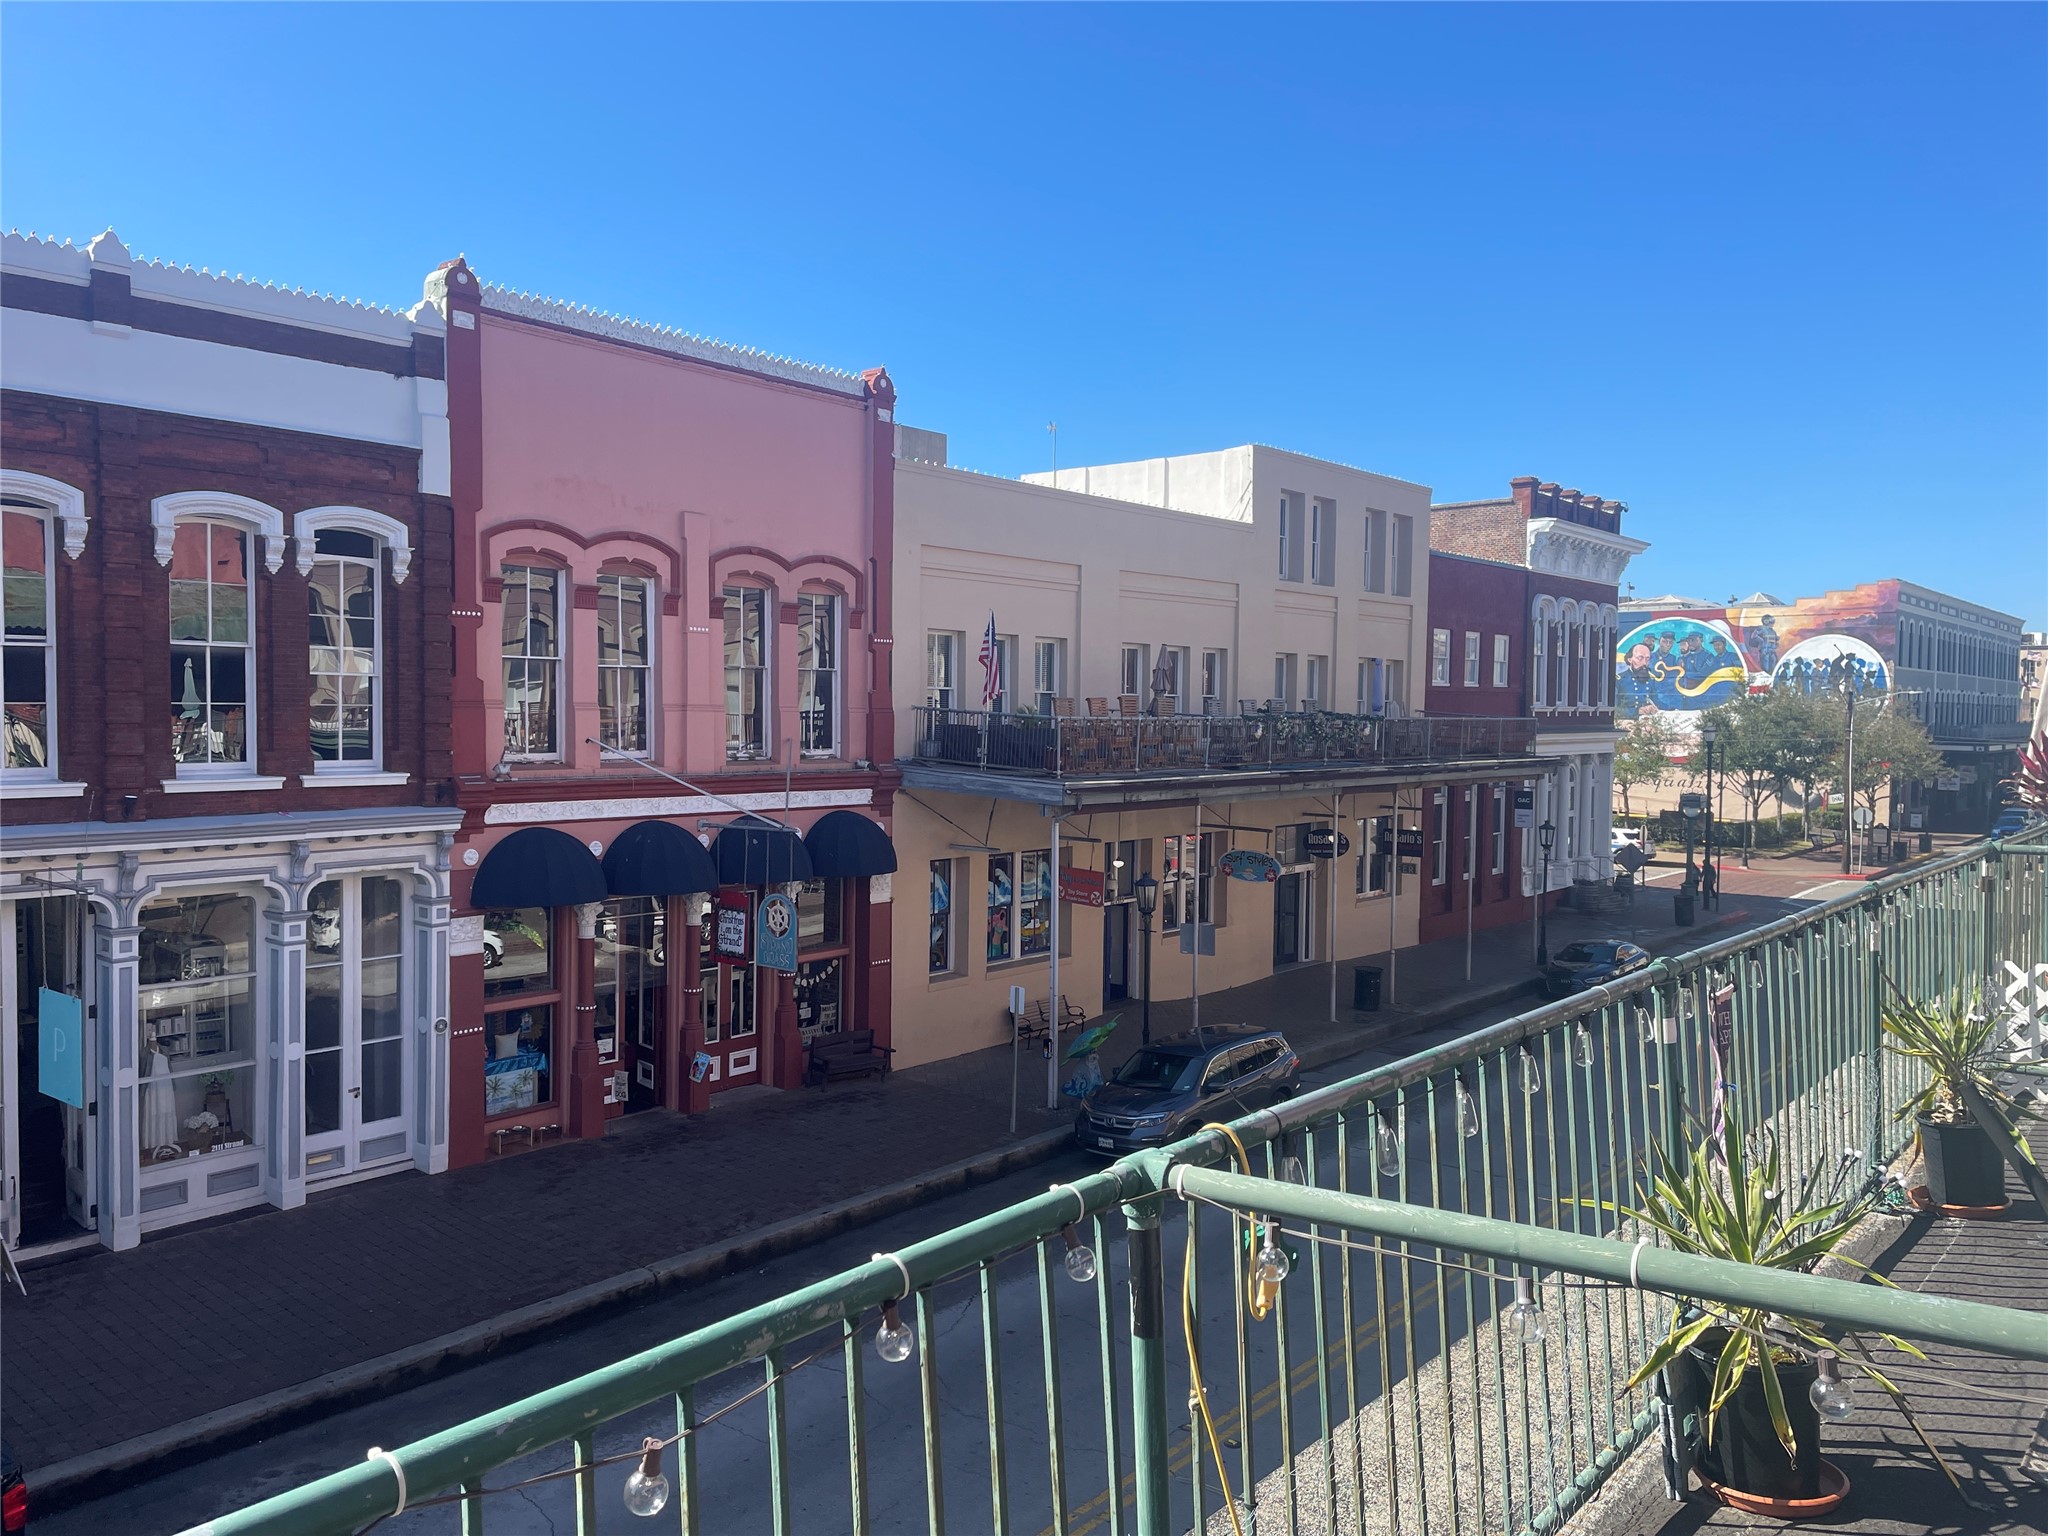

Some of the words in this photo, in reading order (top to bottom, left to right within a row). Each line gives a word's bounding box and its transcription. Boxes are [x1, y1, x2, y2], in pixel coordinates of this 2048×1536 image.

[1308, 833, 1346, 845] Rosa's
[1384, 831, 1422, 844] Roario's
[1225, 851, 1245, 865] Surf
[1247, 853, 1274, 868] Styles
[1395, 864, 1414, 873] EER
[1076, 888, 1088, 897] Store
[719, 914, 744, 925] Christmas
[732, 924, 743, 935] the
[719, 934, 742, 947] Strand
[763, 951, 790, 967] BRASS
[211, 1143, 224, 1152] 2111
